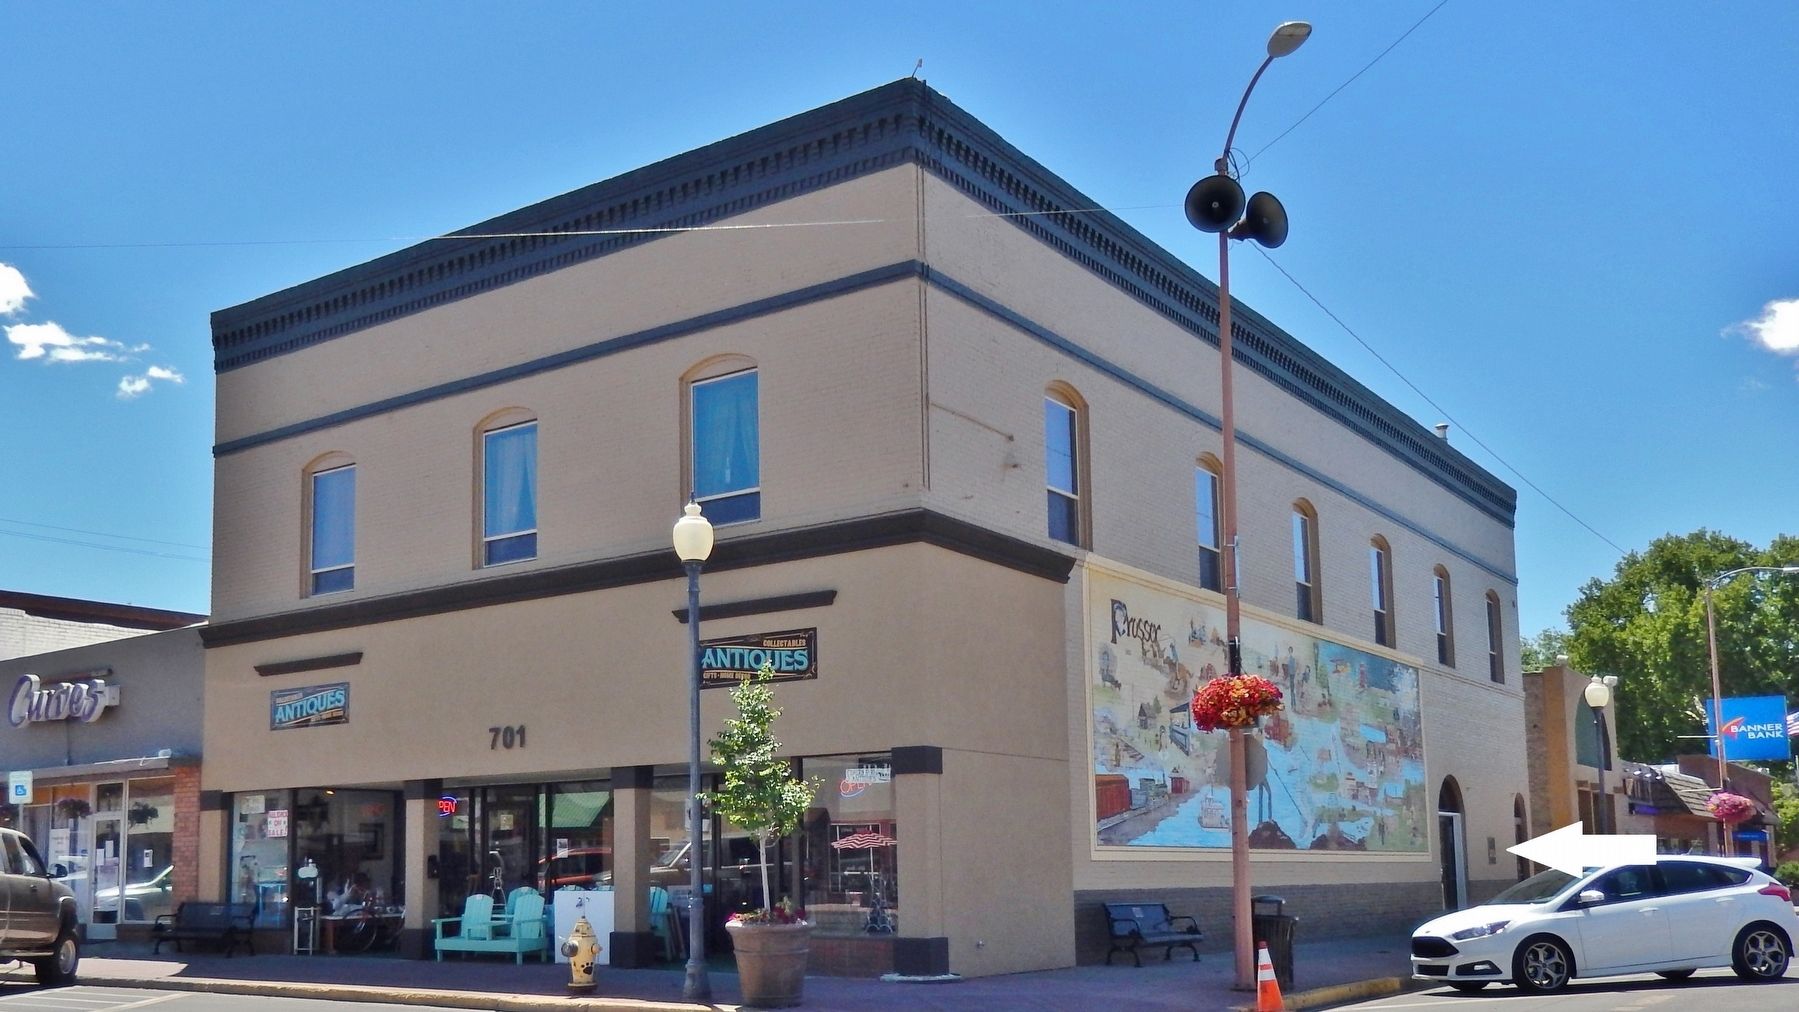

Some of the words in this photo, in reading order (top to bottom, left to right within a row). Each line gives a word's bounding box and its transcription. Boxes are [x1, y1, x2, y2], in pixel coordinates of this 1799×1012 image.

[763, 639, 807, 648] COLLECTABLES
[701, 648, 809, 671] ANTIQUES
[8, 674, 105, 727] Curves
[276, 689, 345, 722] ANTIQUES
[1730, 723, 1783, 733] BANNER
[1748, 731, 1784, 739] BANK
[488, 725, 526, 750] 701
[438, 800, 456, 813] PEN
